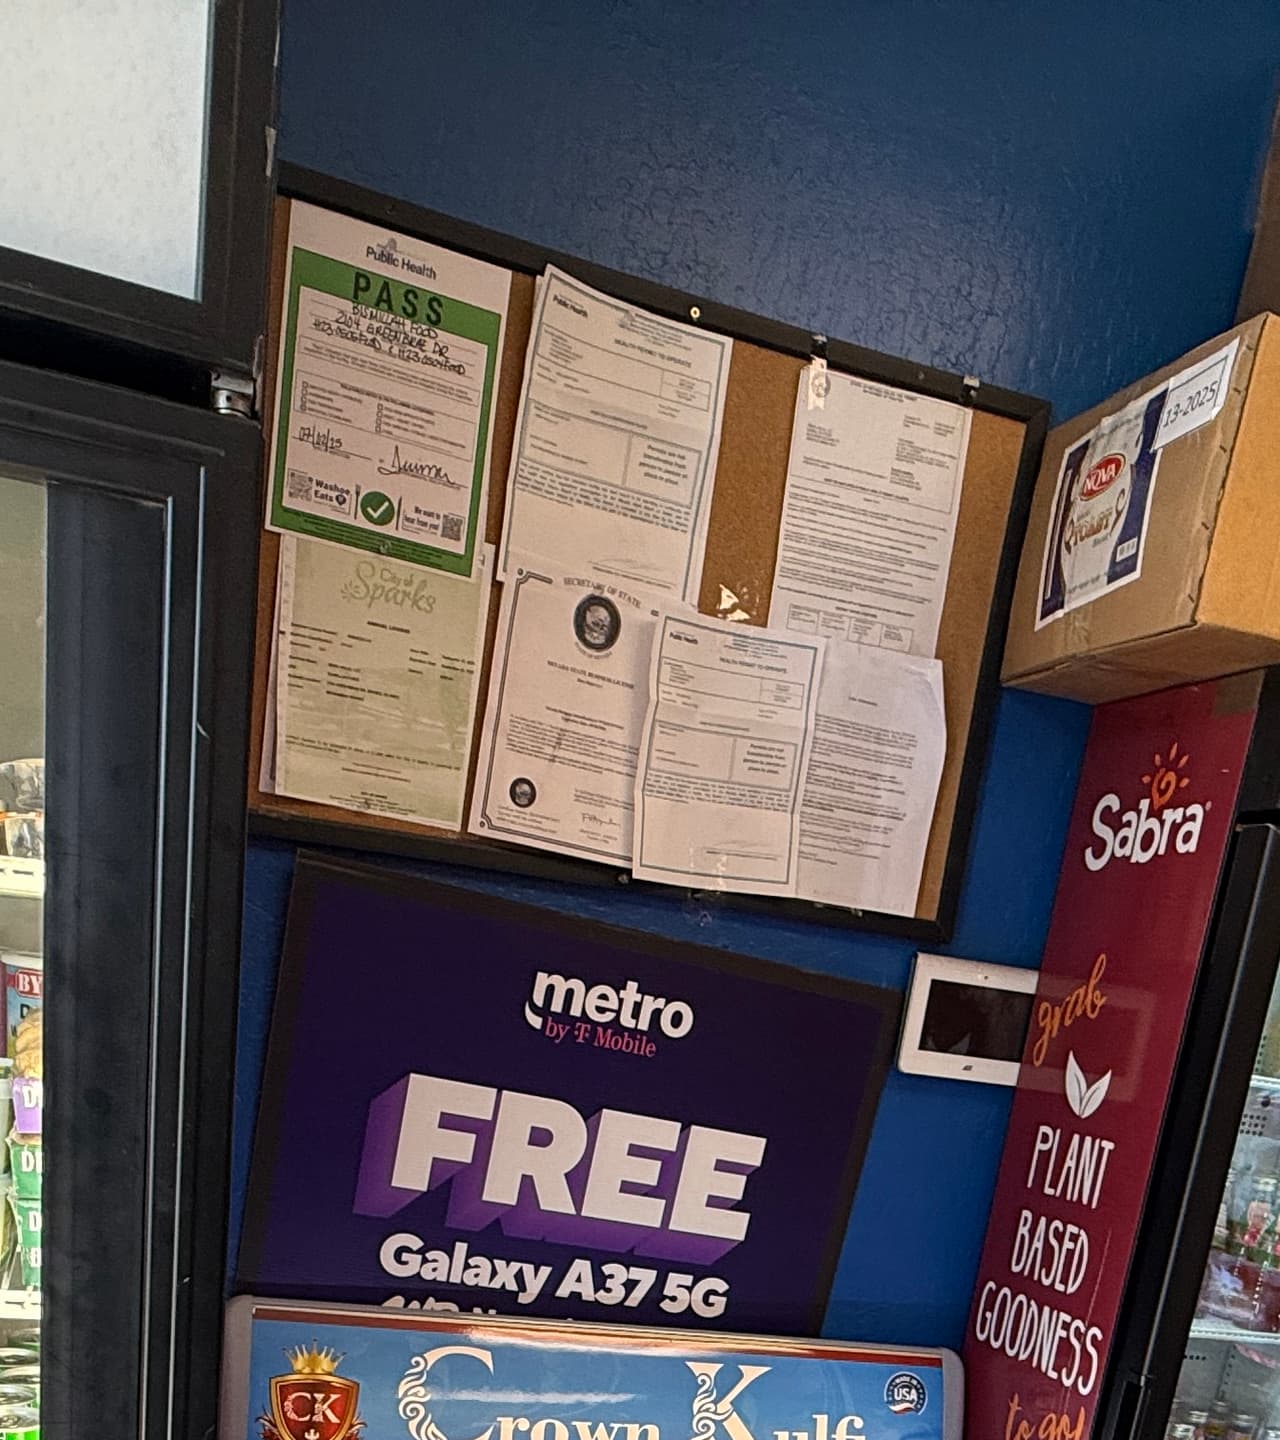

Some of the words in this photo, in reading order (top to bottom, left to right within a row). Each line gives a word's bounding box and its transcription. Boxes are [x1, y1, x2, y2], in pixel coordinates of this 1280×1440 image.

[366, 246, 399, 269] Public
[402, 258, 437, 280] Health
[352, 271, 444, 326] PASS
[1082, 462, 1116, 493] NOVA
[349, 560, 437, 613] Sparks
[563, 577, 606, 595] SECRETARY
[619, 590, 642, 609] STATE
[1084, 792, 1206, 873] Sabra
[526, 970, 695, 1040] metro
[545, 1016, 570, 1044] by
[1031, 953, 1108, 1067] grab
[391, 1072, 767, 1242] FREE
[1027, 1125, 1115, 1209] PLANT
[379, 1232, 553, 1305] Galaxy
[556, 1261, 658, 1309] A37
[662, 1273, 729, 1320] 5G
[1011, 1209, 1090, 1295] BASED
[975, 1280, 1105, 1396] GOODNESS
[283, 1391, 342, 1424] CK
[893, 1388, 918, 1401] USA
